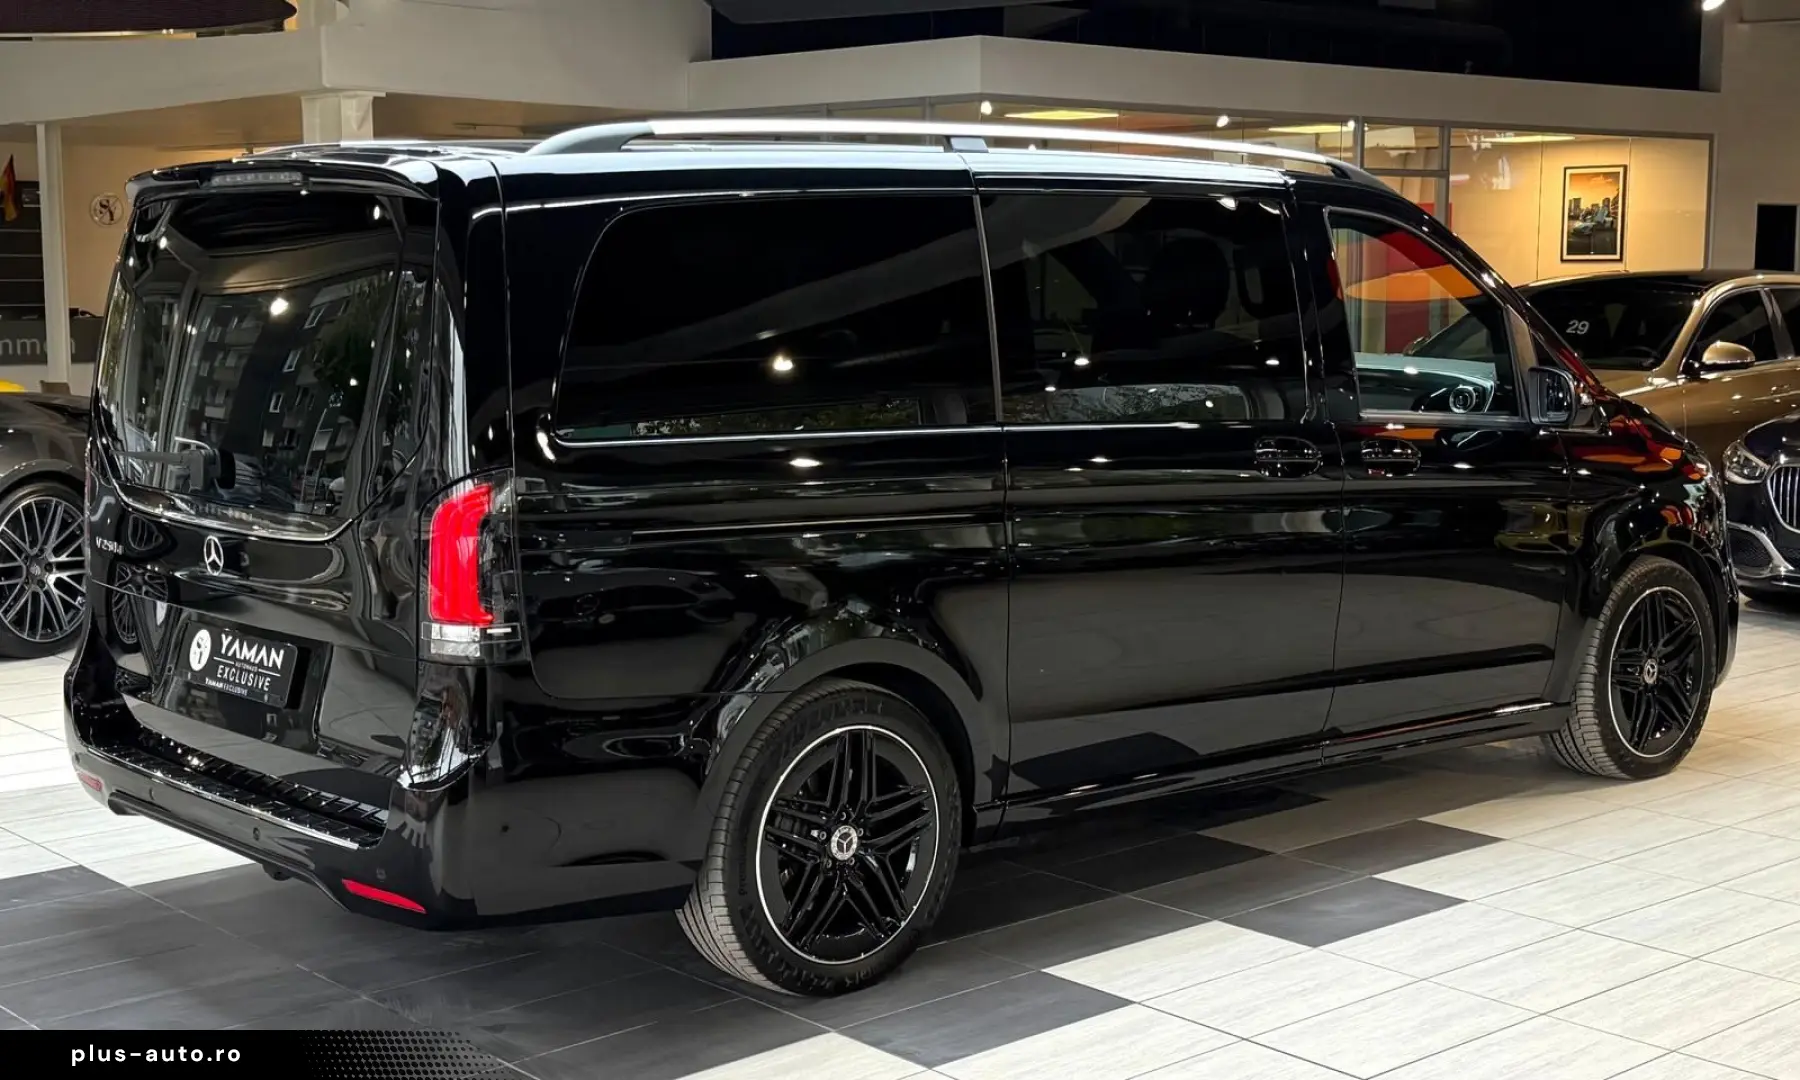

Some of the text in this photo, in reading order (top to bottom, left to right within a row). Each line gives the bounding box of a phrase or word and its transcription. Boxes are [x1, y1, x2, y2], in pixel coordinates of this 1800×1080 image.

[1566, 319, 1590, 335] 29
[221, 633, 285, 670] YAMAN
[216, 664, 271, 692] EXCLUSIVE
